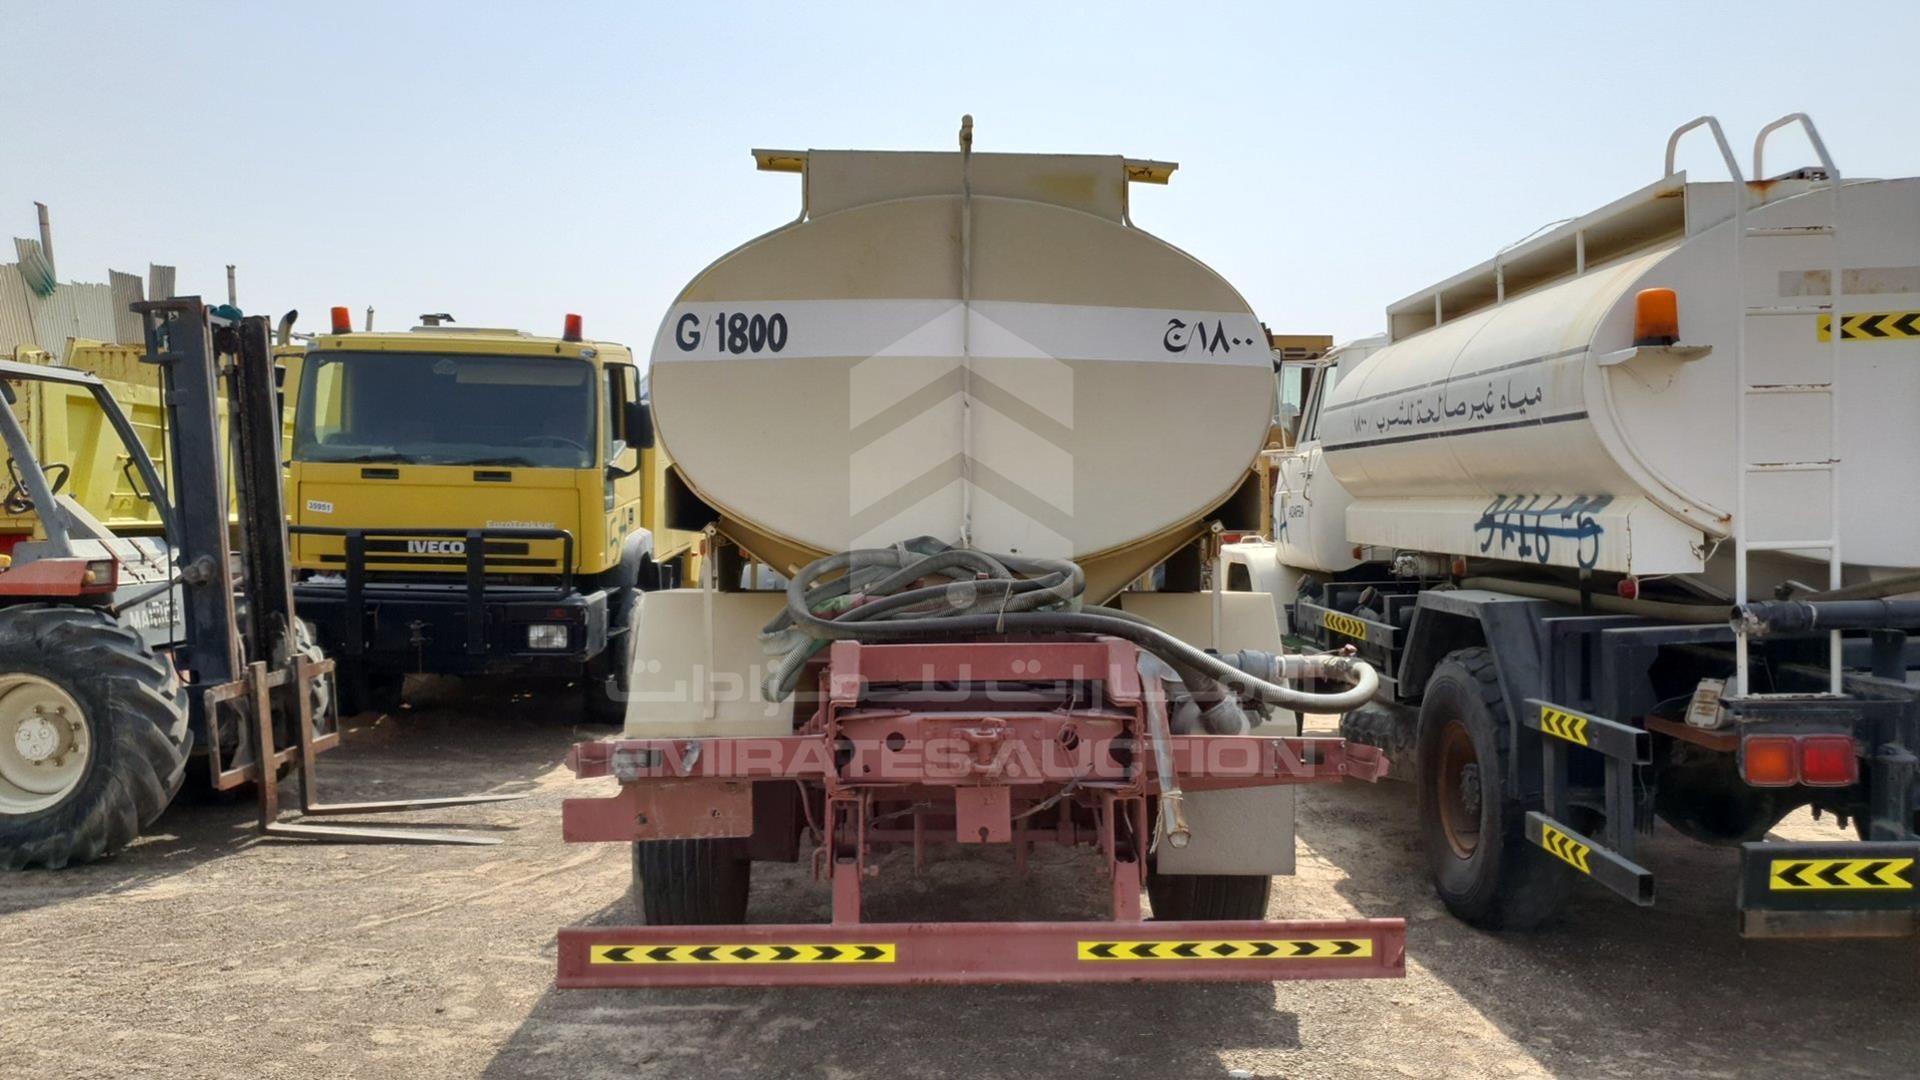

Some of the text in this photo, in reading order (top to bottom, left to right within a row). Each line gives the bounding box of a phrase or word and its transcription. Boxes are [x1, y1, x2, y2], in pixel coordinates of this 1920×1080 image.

[1469, 382, 1495, 420] غير
[1500, 380, 1543, 415] مياه
[407, 540, 466, 554] IVECO
